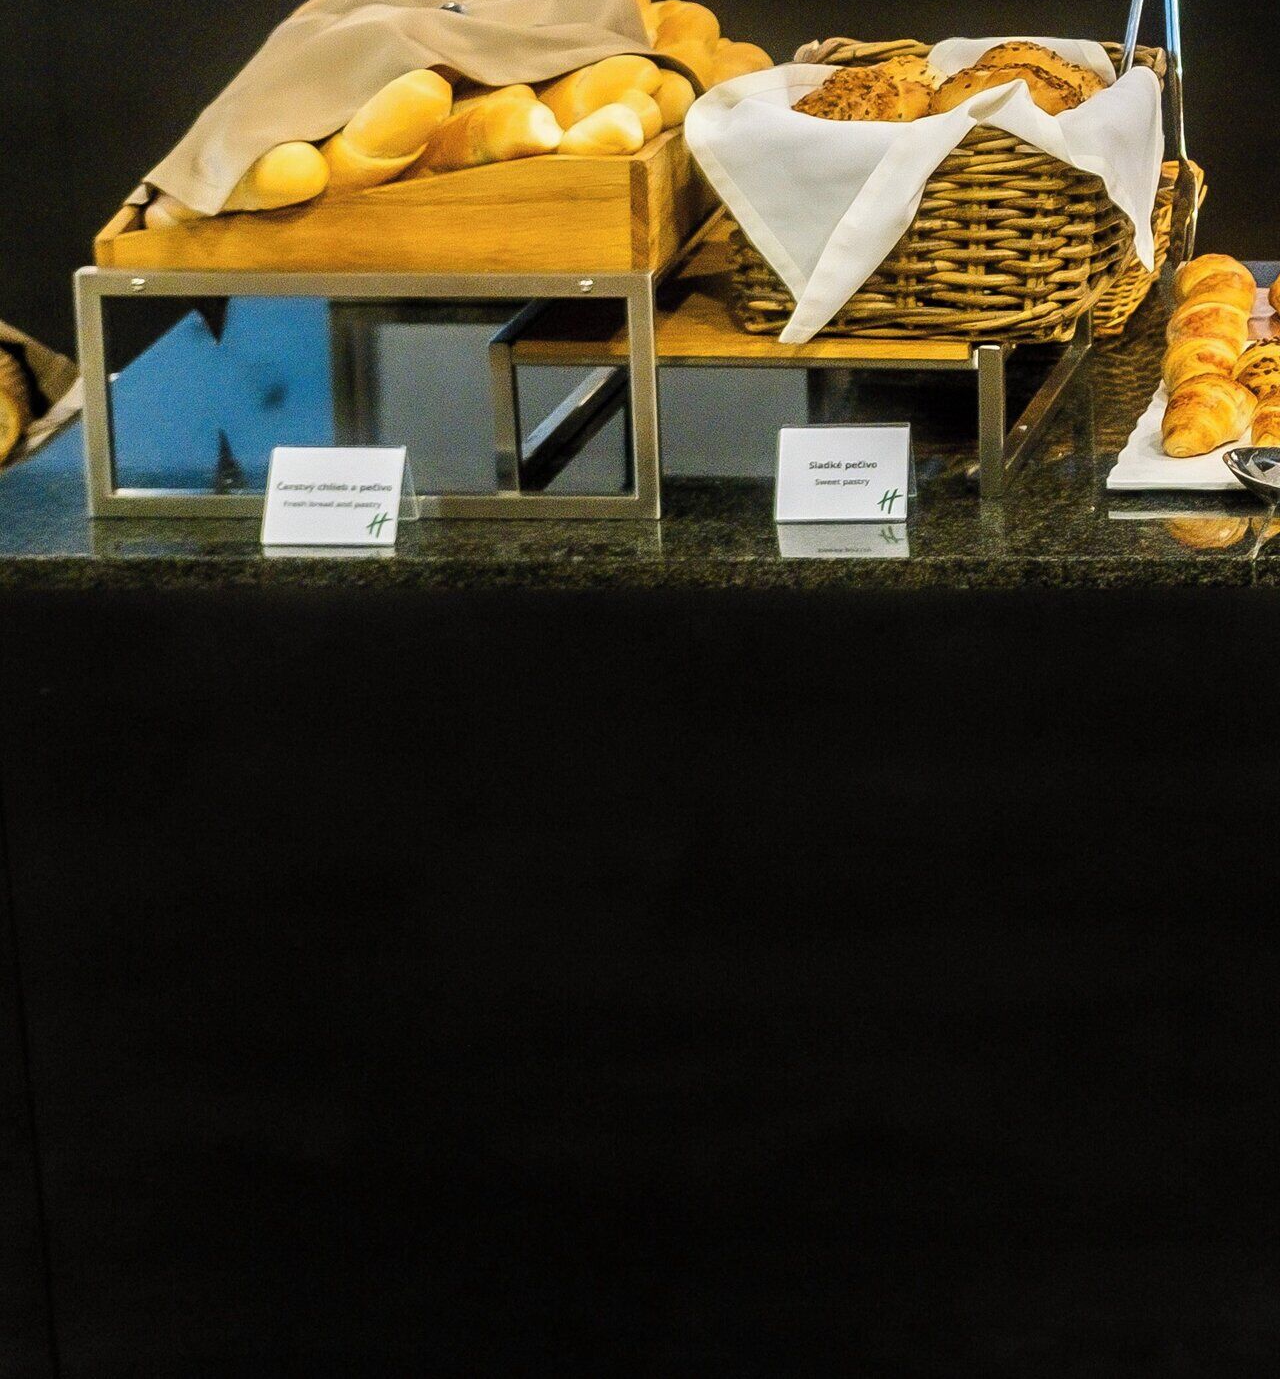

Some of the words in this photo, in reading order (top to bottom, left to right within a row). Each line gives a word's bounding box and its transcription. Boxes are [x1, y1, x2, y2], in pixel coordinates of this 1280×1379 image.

[808, 461, 843, 470] Sladké
[845, 461, 878, 471] pečivo
[843, 479, 870, 487] pastry
